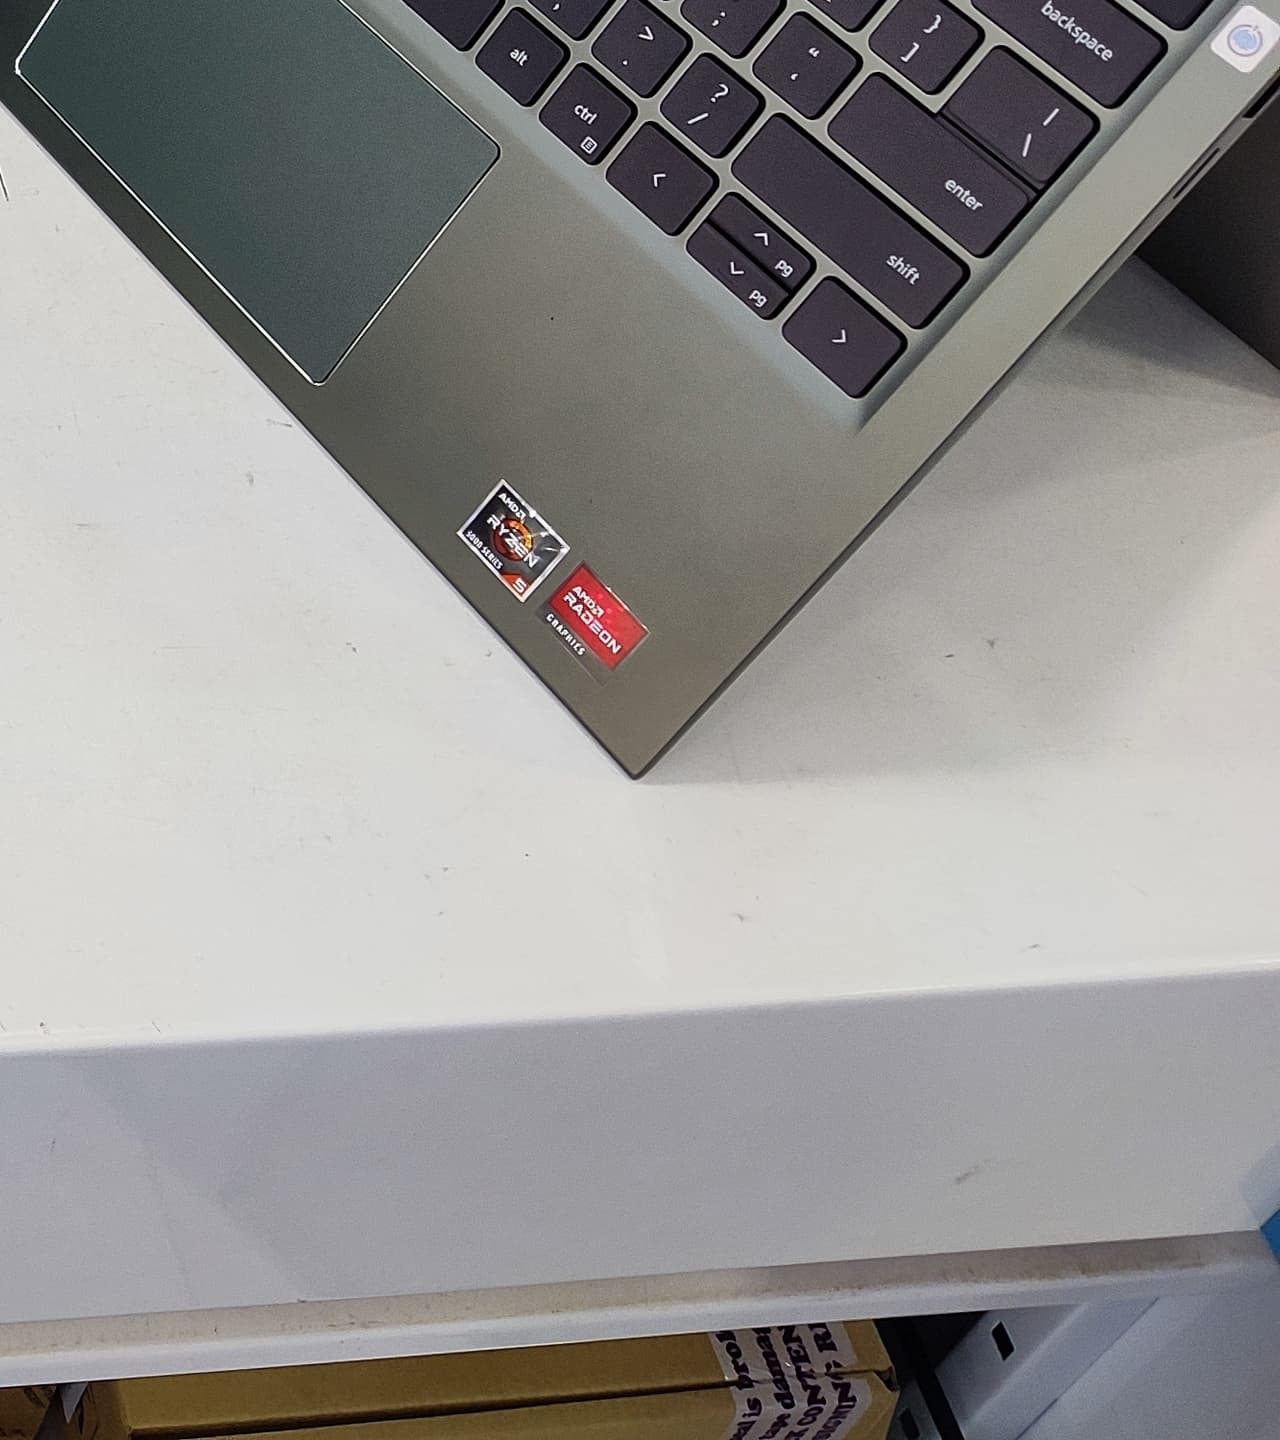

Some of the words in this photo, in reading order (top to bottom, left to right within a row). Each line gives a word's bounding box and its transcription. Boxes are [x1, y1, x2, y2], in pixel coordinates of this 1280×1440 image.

[1041, 0, 1113, 62] backspace
[509, 49, 528, 66] alt
[574, 104, 598, 125] ctrl
[945, 179, 983, 211] enter
[886, 255, 920, 285] shift
[486, 513, 539, 569] RYZEN
[513, 577, 528, 593] 5
[572, 585, 605, 618] AMD
[562, 591, 622, 655] RADEON
